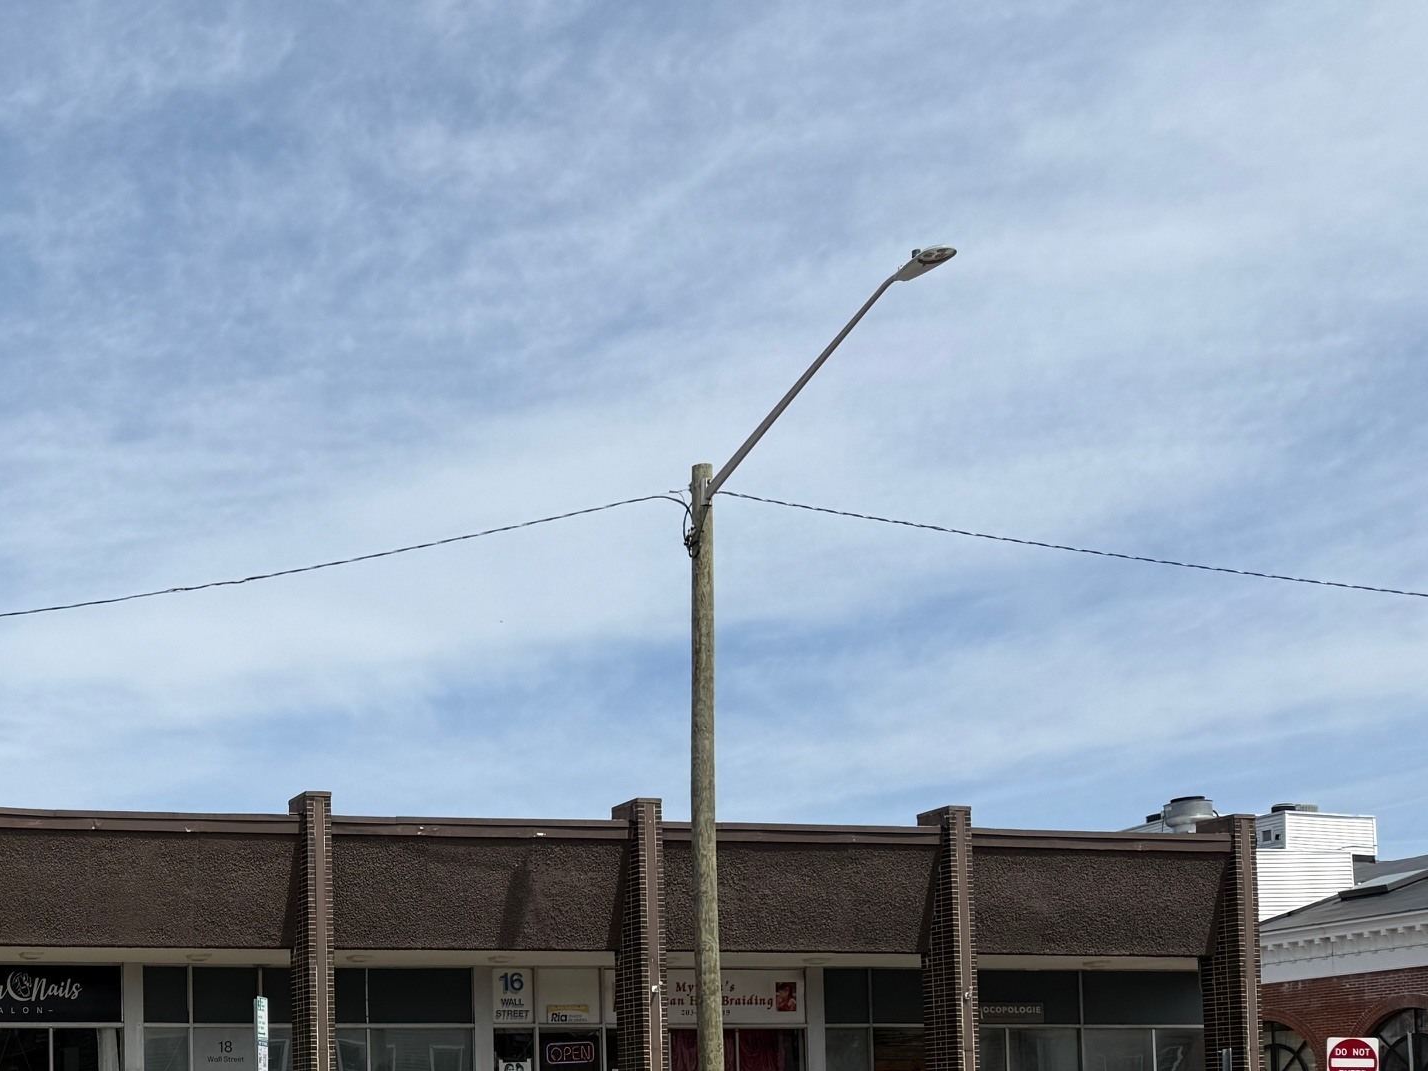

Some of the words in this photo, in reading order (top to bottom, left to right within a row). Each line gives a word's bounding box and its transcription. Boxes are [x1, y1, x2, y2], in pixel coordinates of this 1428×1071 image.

[31, 978, 83, 1001] Nails
[499, 972, 524, 994] 16
[501, 998, 524, 1006] WALL
[722, 996, 774, 1009] Braiding
[495, 1009, 529, 1019] STREET
[551, 1012, 568, 1022] Ria
[219, 1040, 232, 1053] 18
[550, 1045, 590, 1061] OPEN
[1335, 1048, 1348, 1056] DO
[1353, 1048, 1370, 1056] NOT
